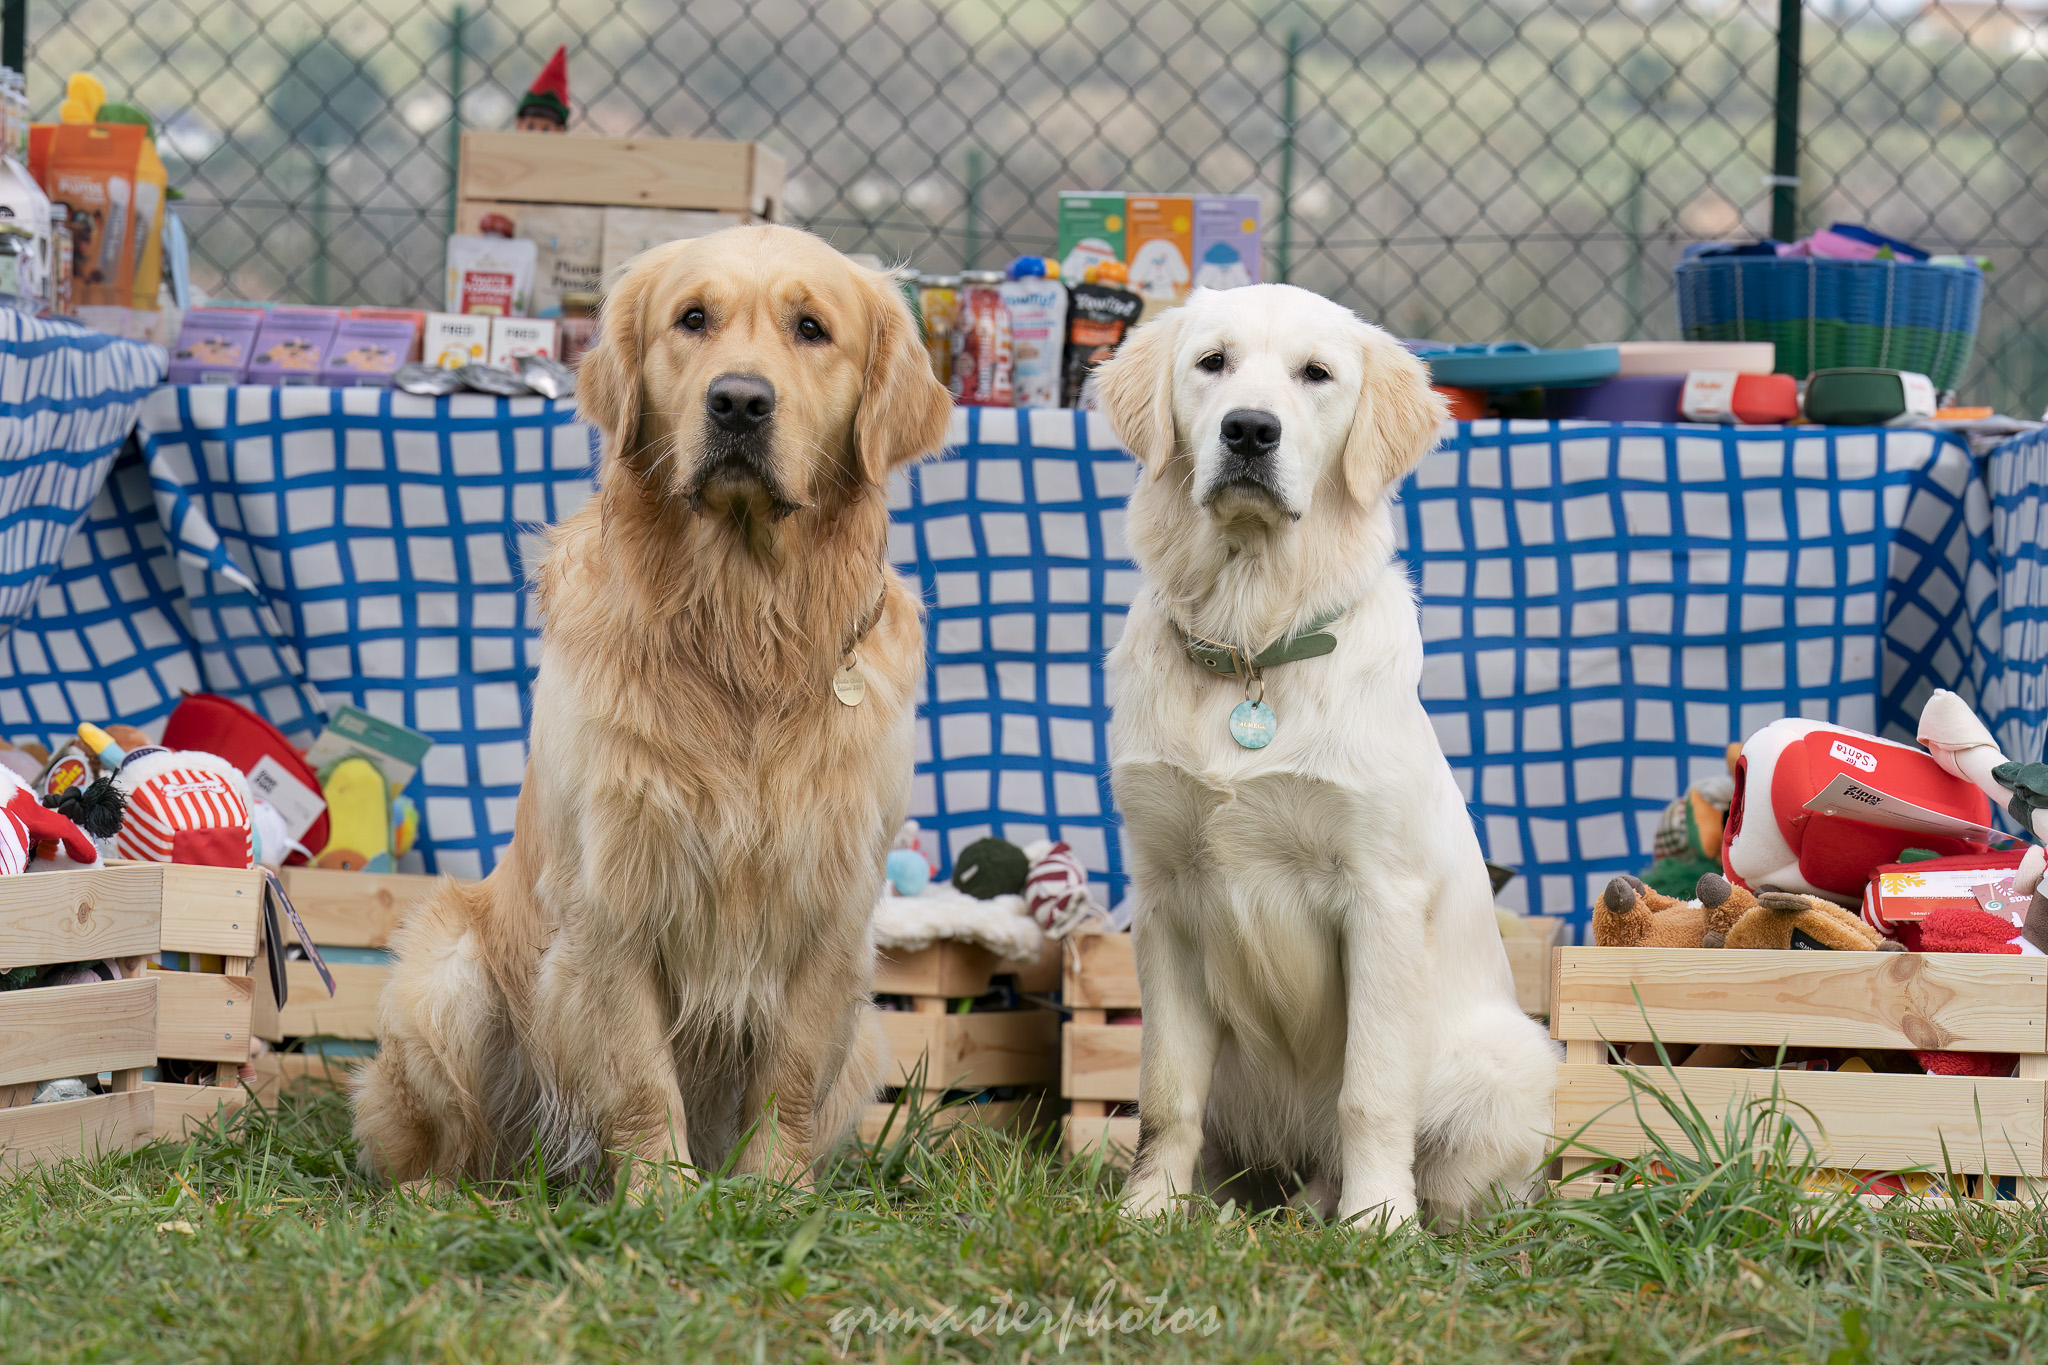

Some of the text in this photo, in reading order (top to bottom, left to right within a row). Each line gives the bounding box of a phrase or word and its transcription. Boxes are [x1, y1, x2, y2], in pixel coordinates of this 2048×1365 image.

[1836, 744, 1870, 766] Santa
[1843, 790, 1880, 806] Paws
[1847, 784, 1884, 802] Zippy
